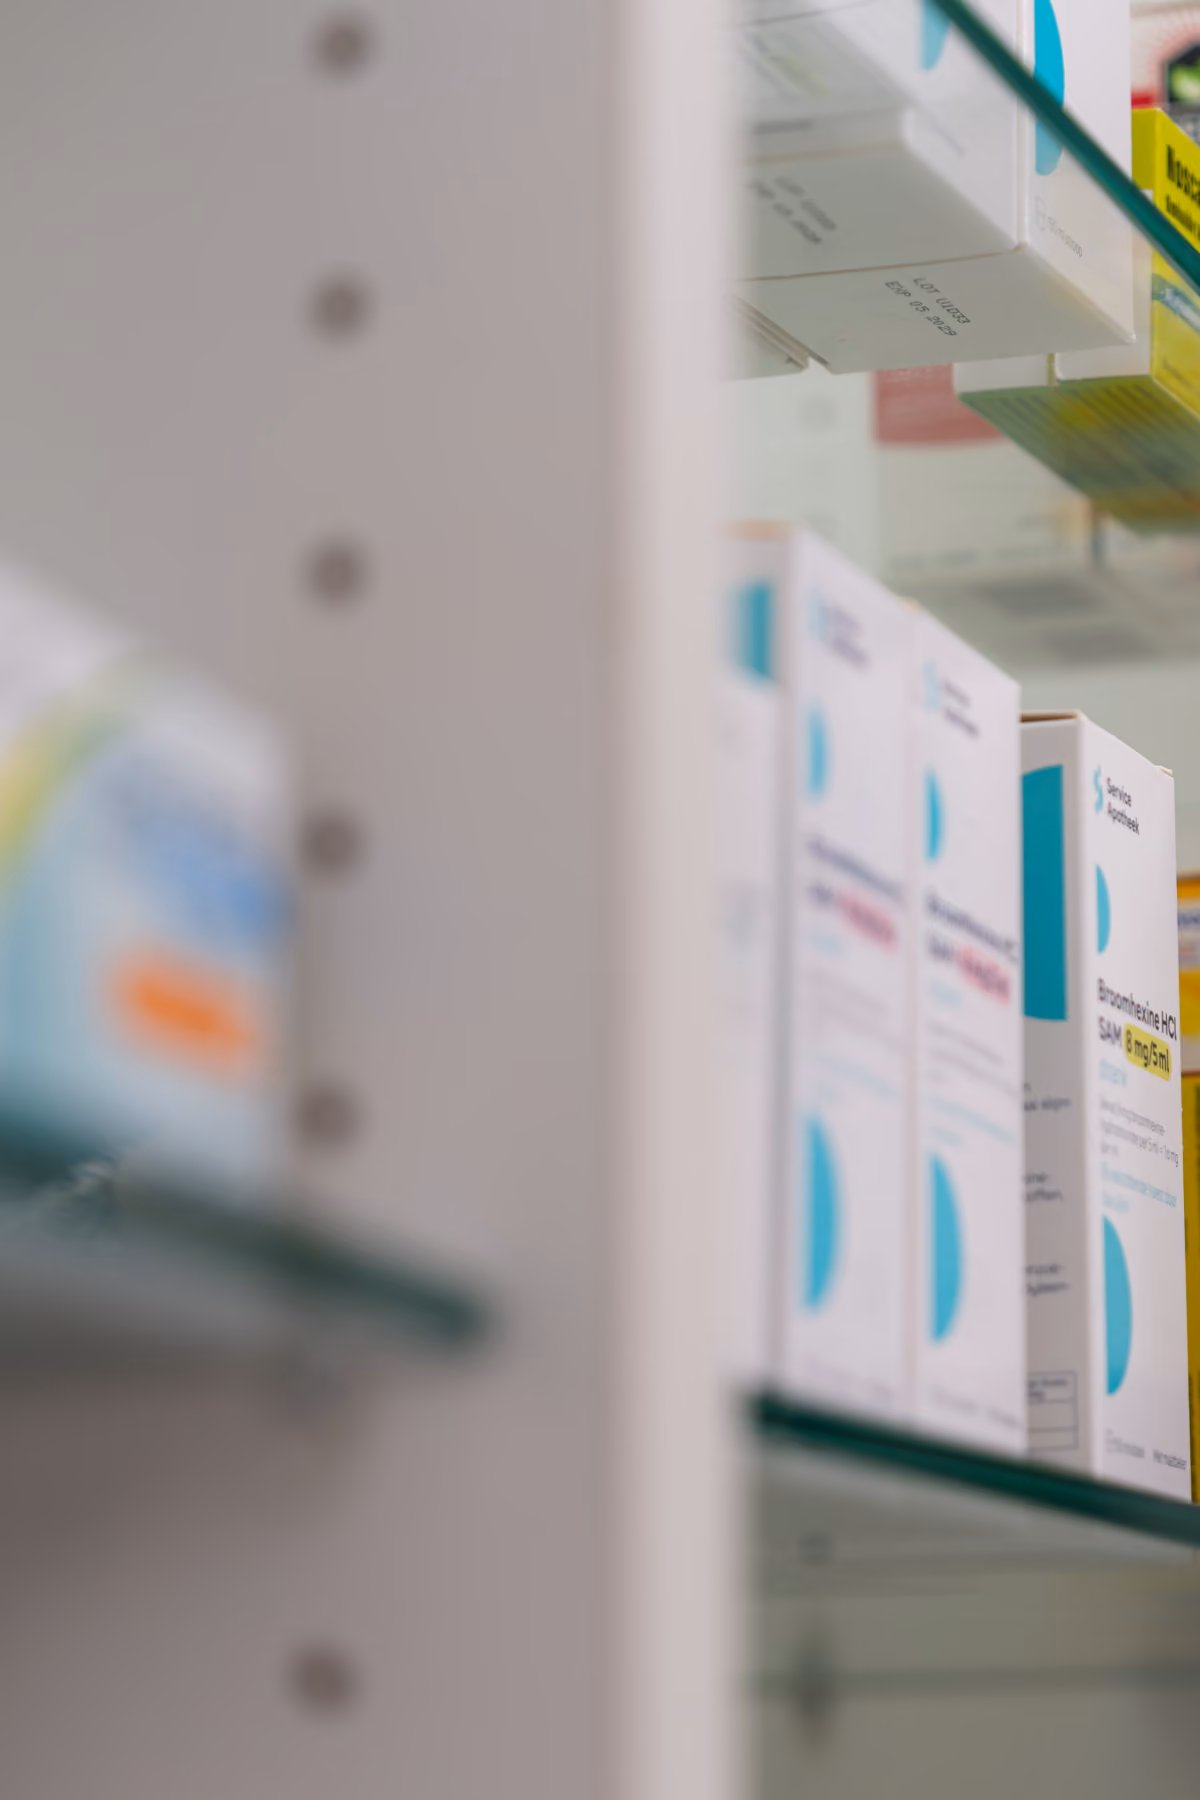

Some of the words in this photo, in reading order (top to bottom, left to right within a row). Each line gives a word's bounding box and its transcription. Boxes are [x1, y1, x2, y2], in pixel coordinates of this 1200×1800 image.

[885, 280, 911, 297] EXP
[913, 276, 941, 294] LOT
[1107, 777, 1132, 808] Service
[1107, 801, 1140, 835] Apotheek
[1098, 977, 1160, 1031] Broomhexine
[1161, 1010, 1178, 1041] HCl
[1099, 1015, 1122, 1048] SAM
[1126, 1029, 1132, 1053] 8
